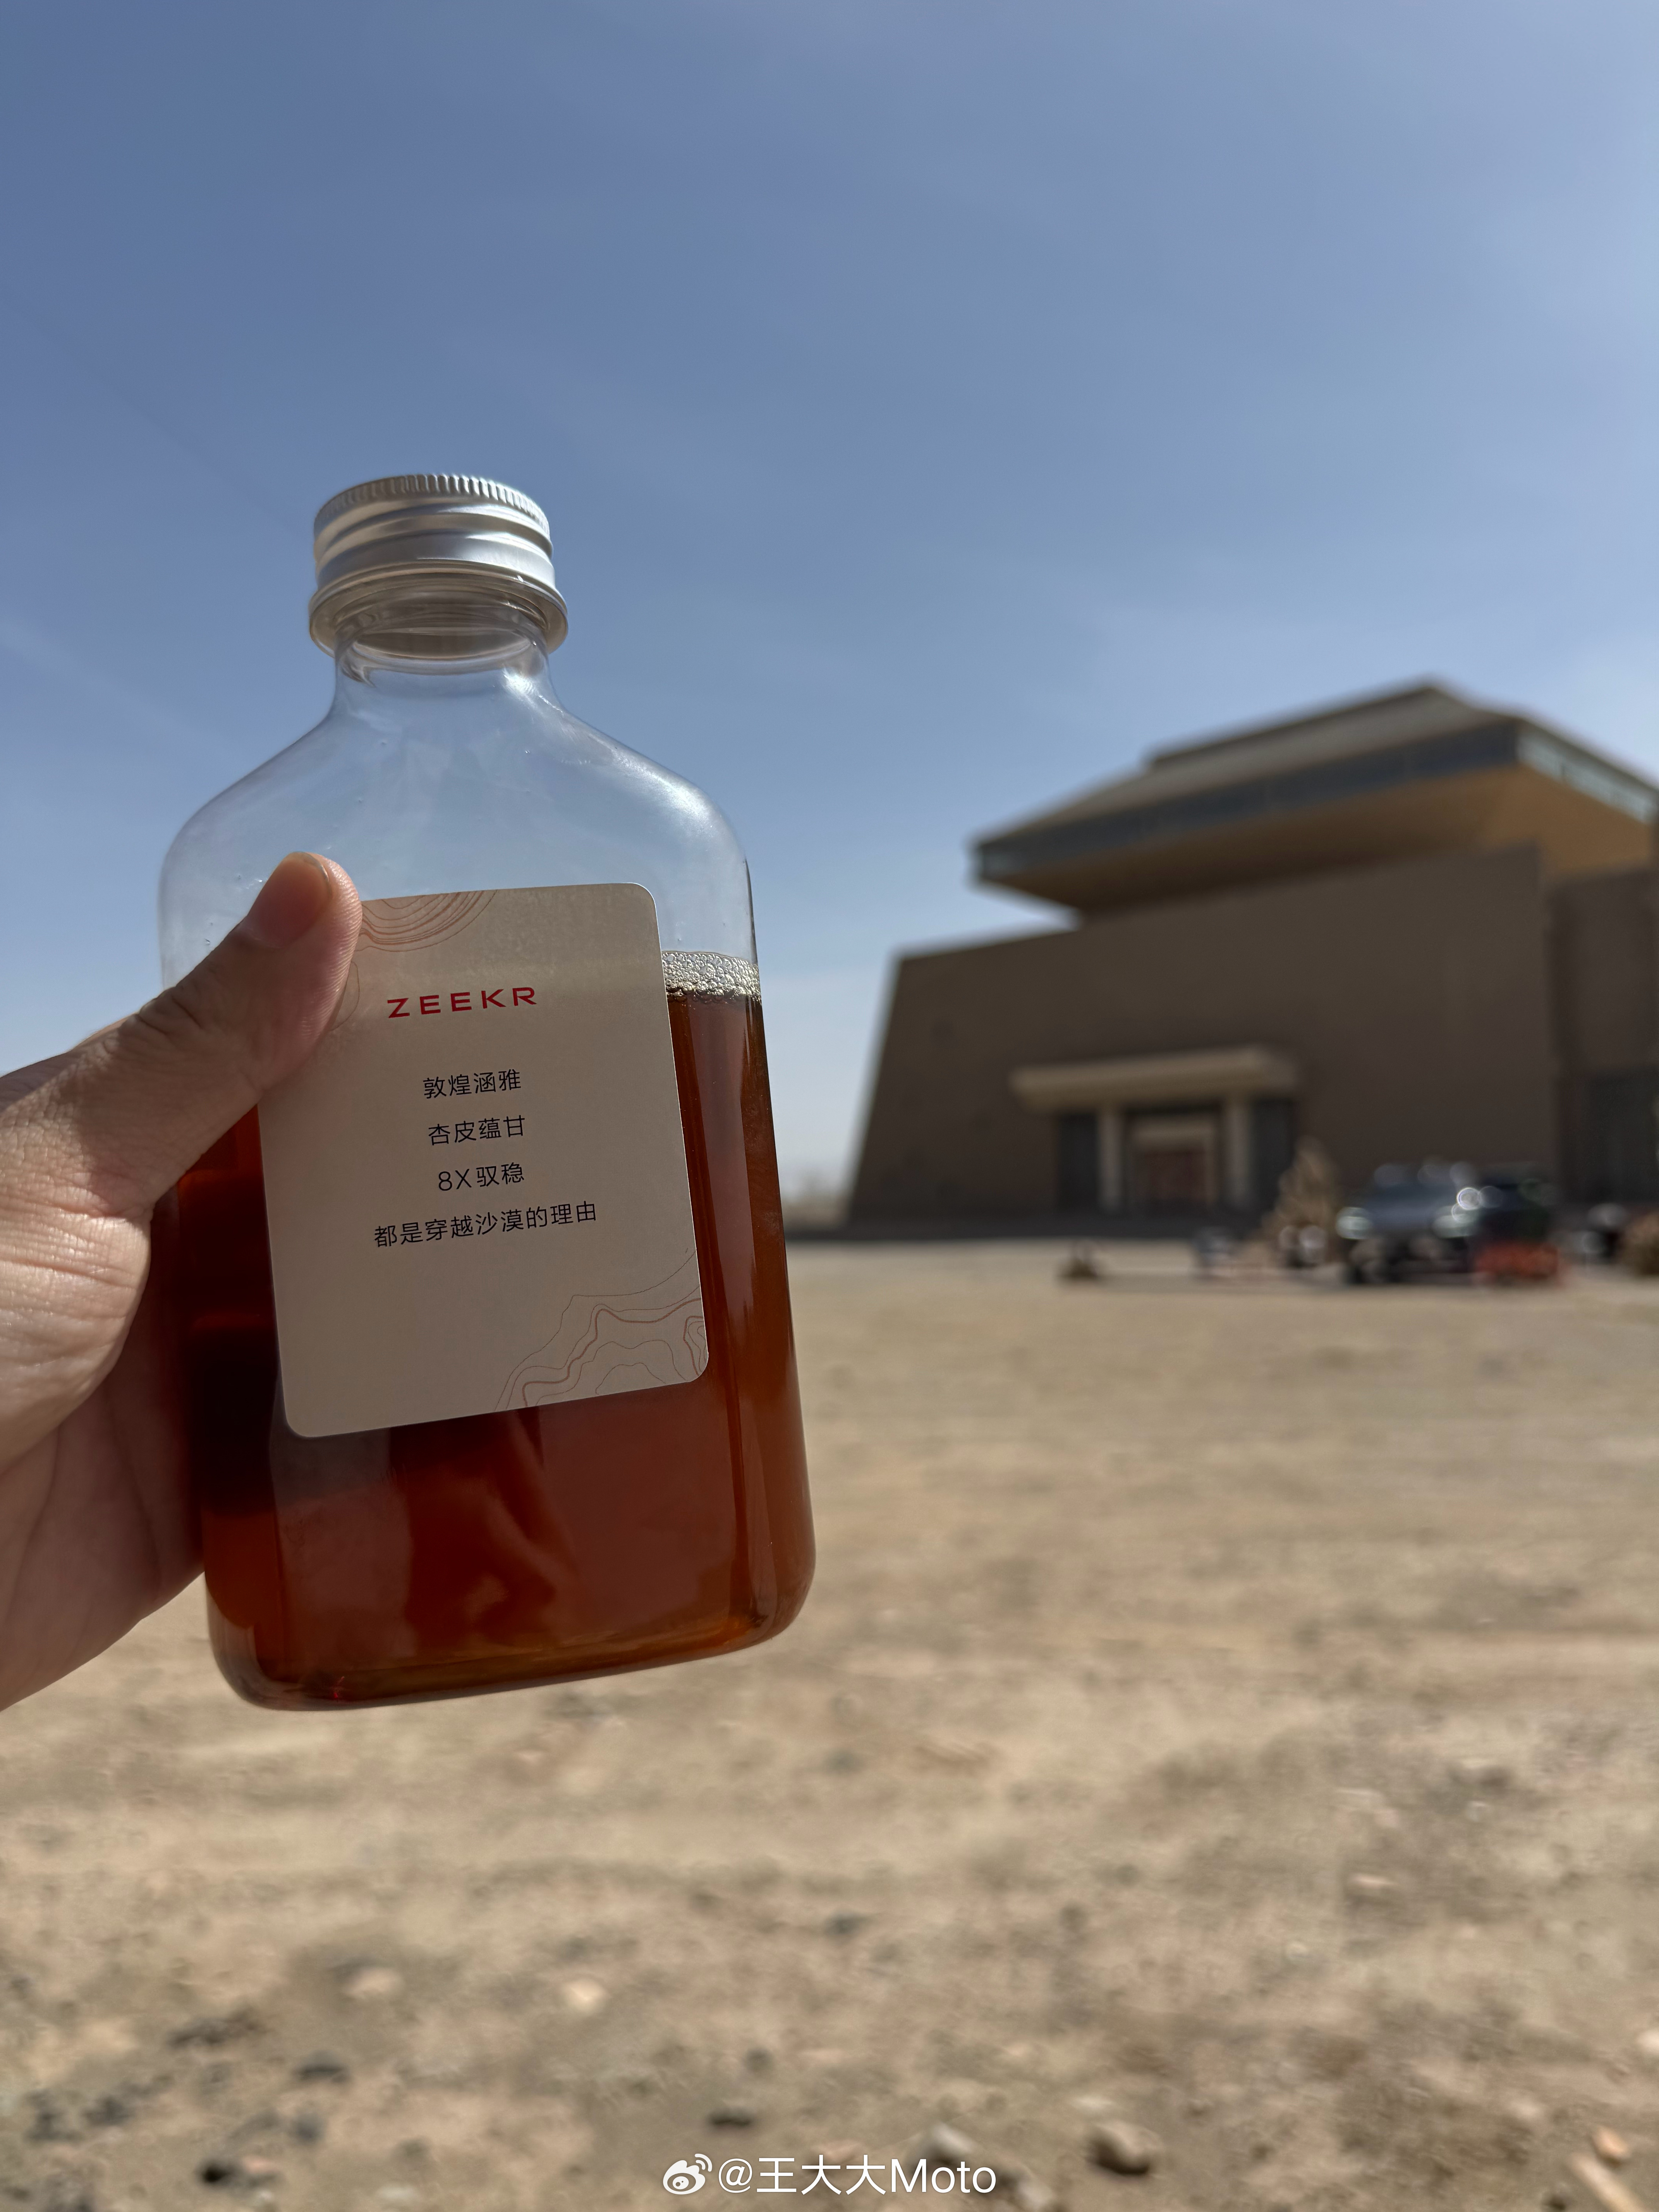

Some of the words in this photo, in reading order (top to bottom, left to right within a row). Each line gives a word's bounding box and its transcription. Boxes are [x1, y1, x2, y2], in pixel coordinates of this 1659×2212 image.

[387, 987, 537, 1018] ZEEKR
[422, 1068, 522, 1099] 敦煌涵雅
[428, 1114, 526, 1146] 杏皮蕴甘
[374, 1200, 597, 1248] 都是穿越沙漠的理由
